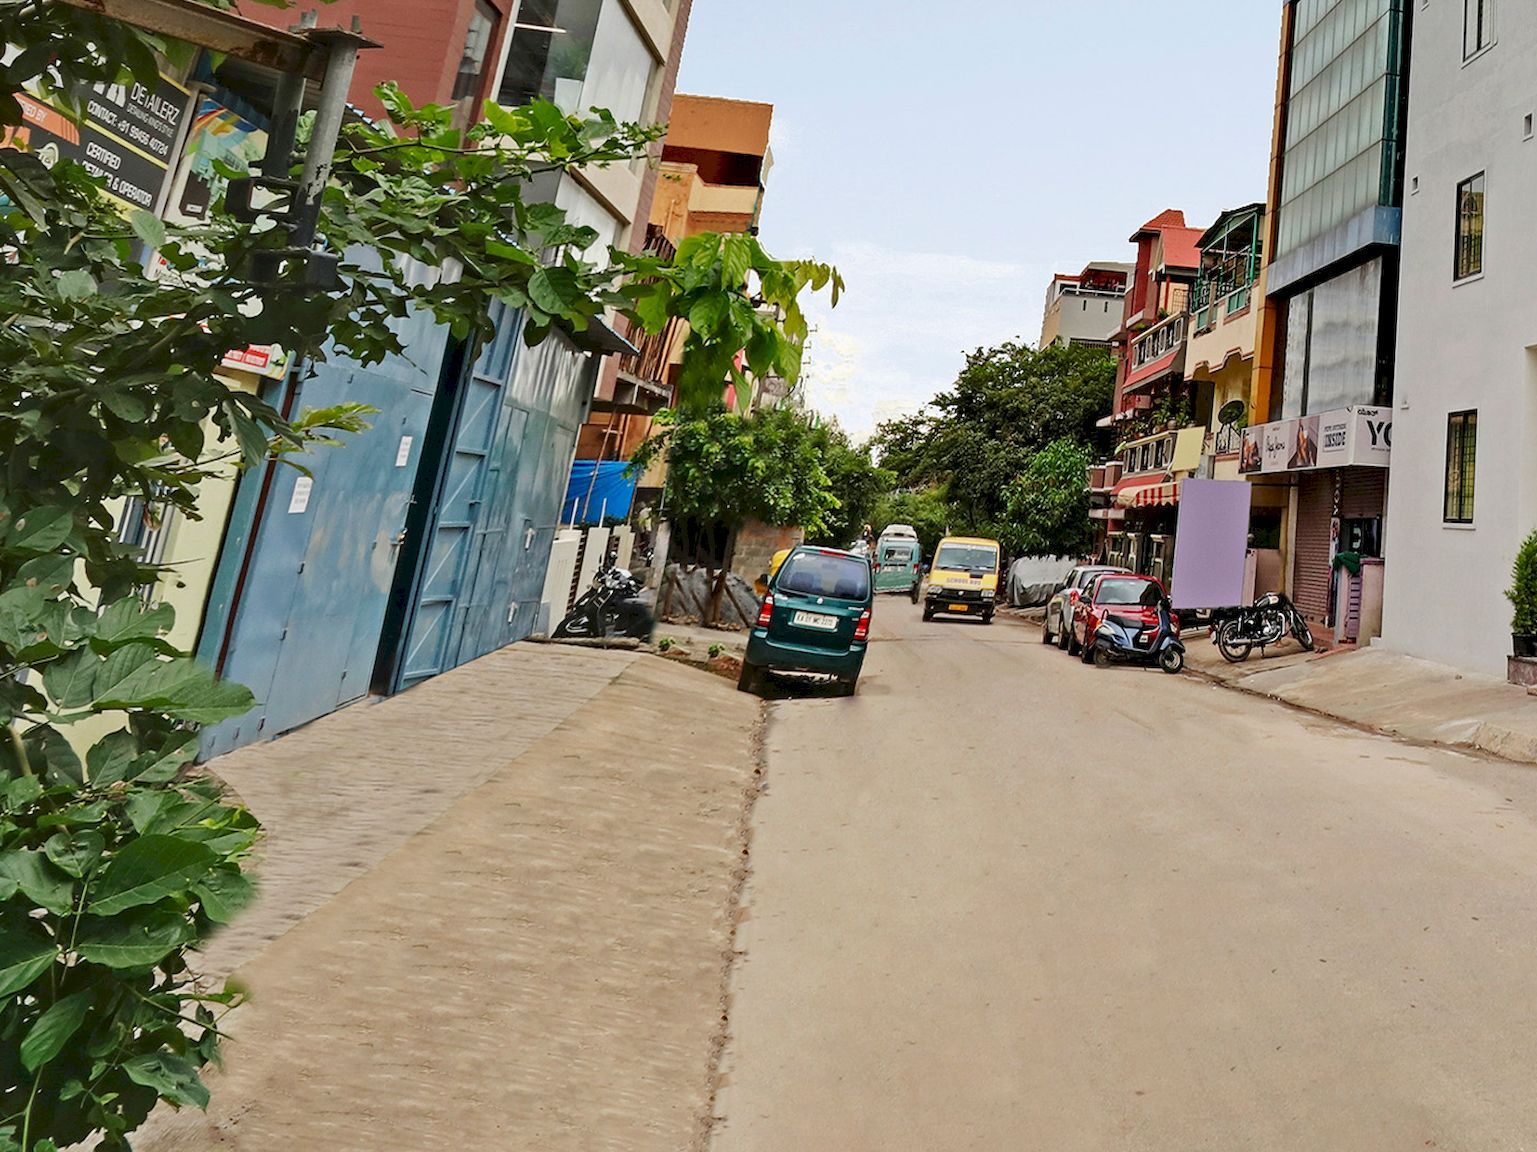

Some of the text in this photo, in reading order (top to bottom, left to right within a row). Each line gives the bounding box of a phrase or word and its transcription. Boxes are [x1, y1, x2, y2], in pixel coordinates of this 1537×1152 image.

[85, 141, 122, 171] CERTIFIED
[112, 178, 120, 191] &
[119, 180, 153, 208] OPERATOR
